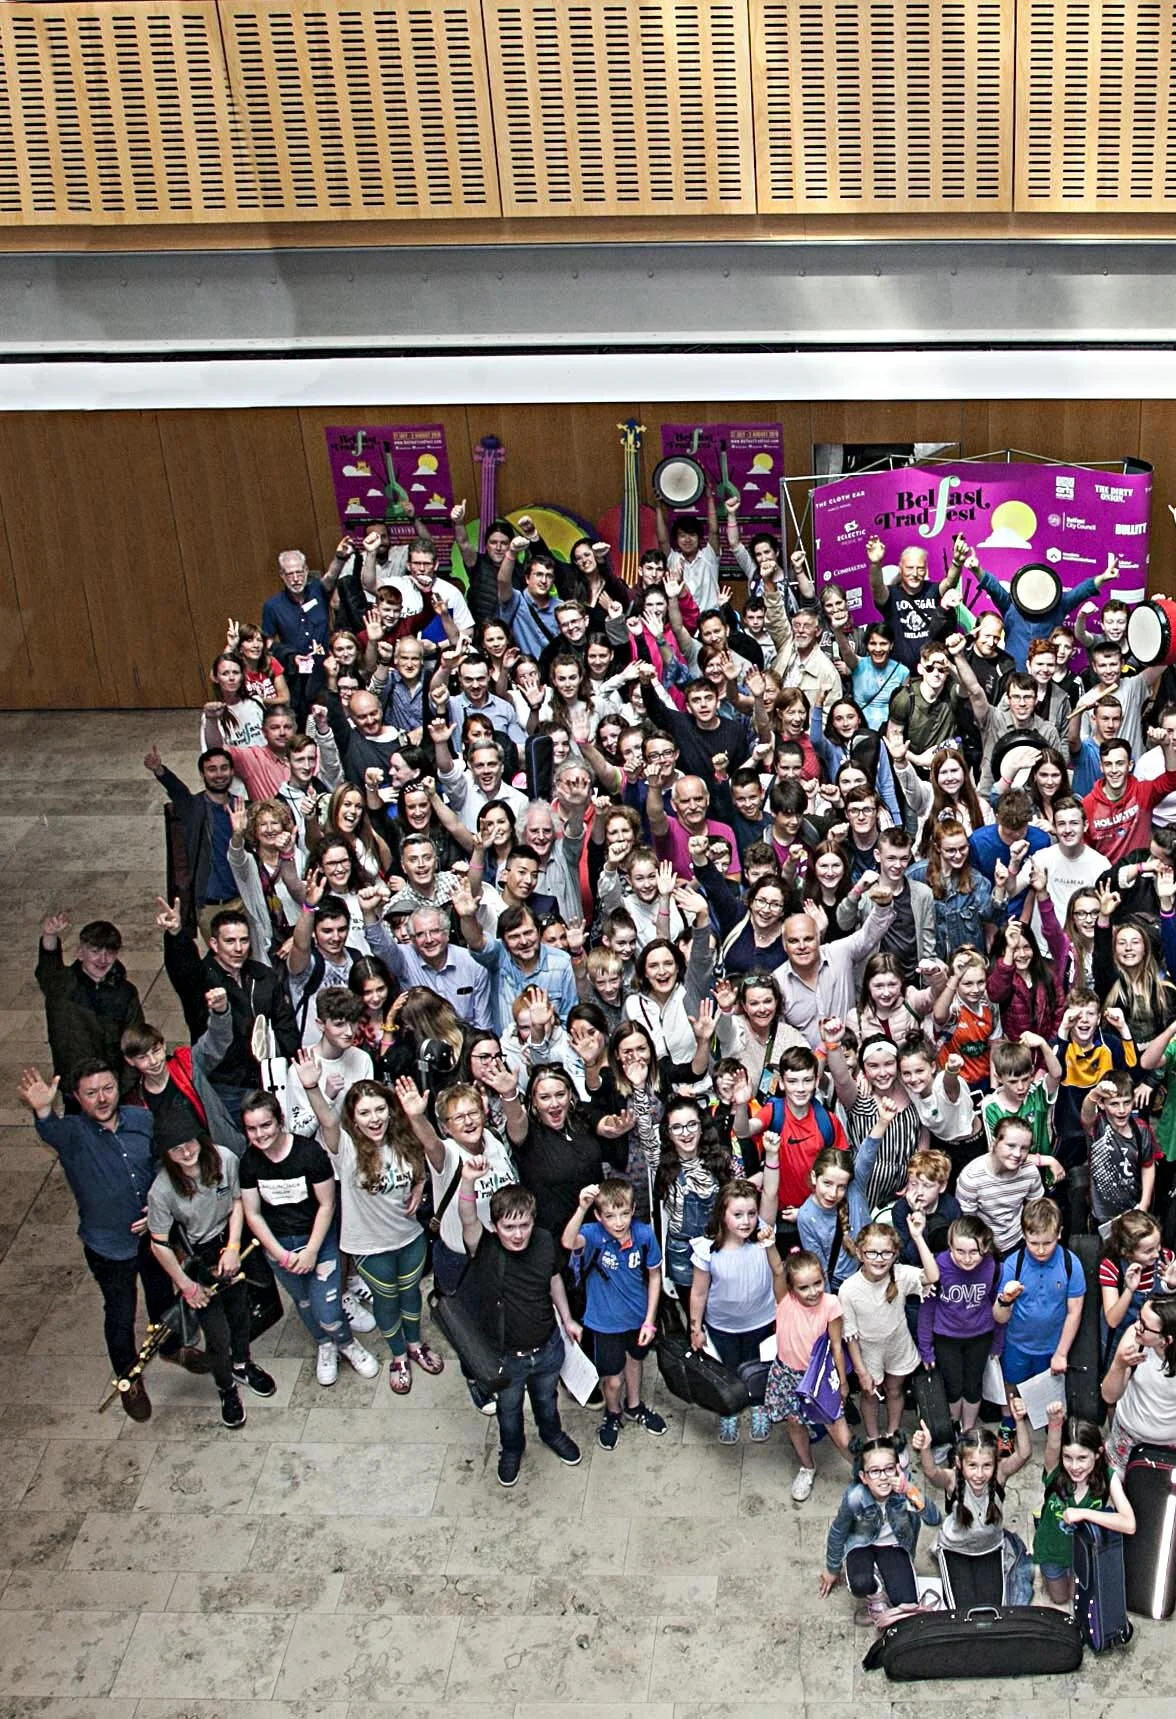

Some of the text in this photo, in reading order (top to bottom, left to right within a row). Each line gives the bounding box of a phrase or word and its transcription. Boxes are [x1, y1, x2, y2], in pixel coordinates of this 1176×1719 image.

[897, 475, 991, 510] Belfast
[836, 528, 867, 542] ECLECTIC
[939, 1282, 987, 1303] LOVE
